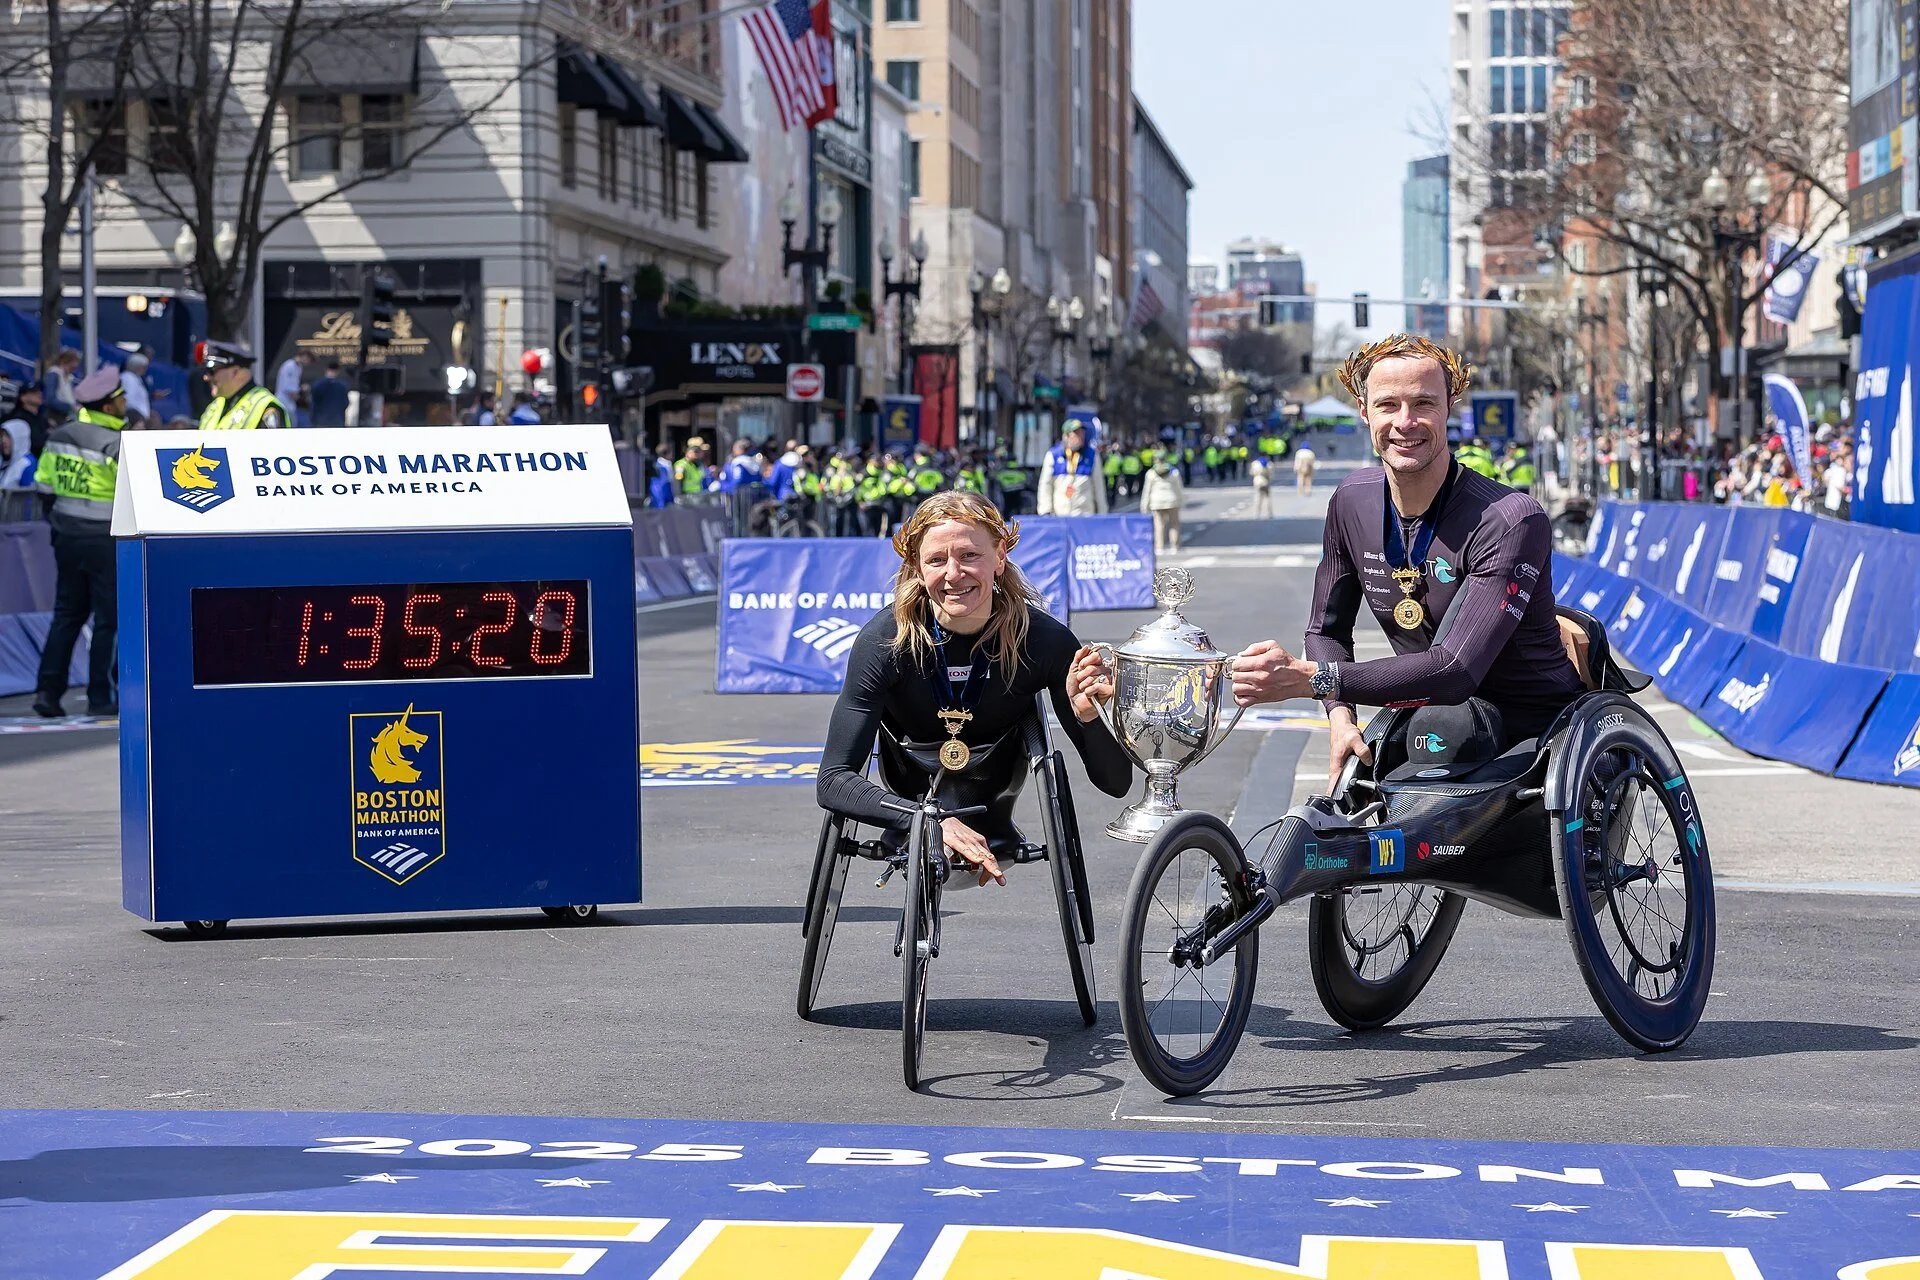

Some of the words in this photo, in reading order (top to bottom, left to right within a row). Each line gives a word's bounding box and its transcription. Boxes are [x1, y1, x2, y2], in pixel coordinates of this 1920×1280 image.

[691, 342, 782, 365] LENOX
[250, 455, 388, 477] BOSTON
[398, 452, 588, 474] MARATHON
[255, 484, 324, 497] BANK
[331, 483, 362, 495] OF
[370, 481, 483, 495] AMERICA
[729, 592, 793, 609] BANK
[798, 592, 829, 609] OF
[298, 590, 576, 669] 1:35:20
[356, 789, 440, 809] BOSTON
[357, 809, 440, 825] MARATHON
[357, 830, 383, 838] BANK
[384, 829, 397, 837] OF
[398, 828, 440, 837] AMERICA
[1377, 838, 1395, 867] W1
[1432, 844, 1466, 856] SAUBER
[1317, 856, 1349, 870] Orthotec
[302, 1136, 746, 1162] 2025
[806, 1147, 1605, 1185] BOSTON
